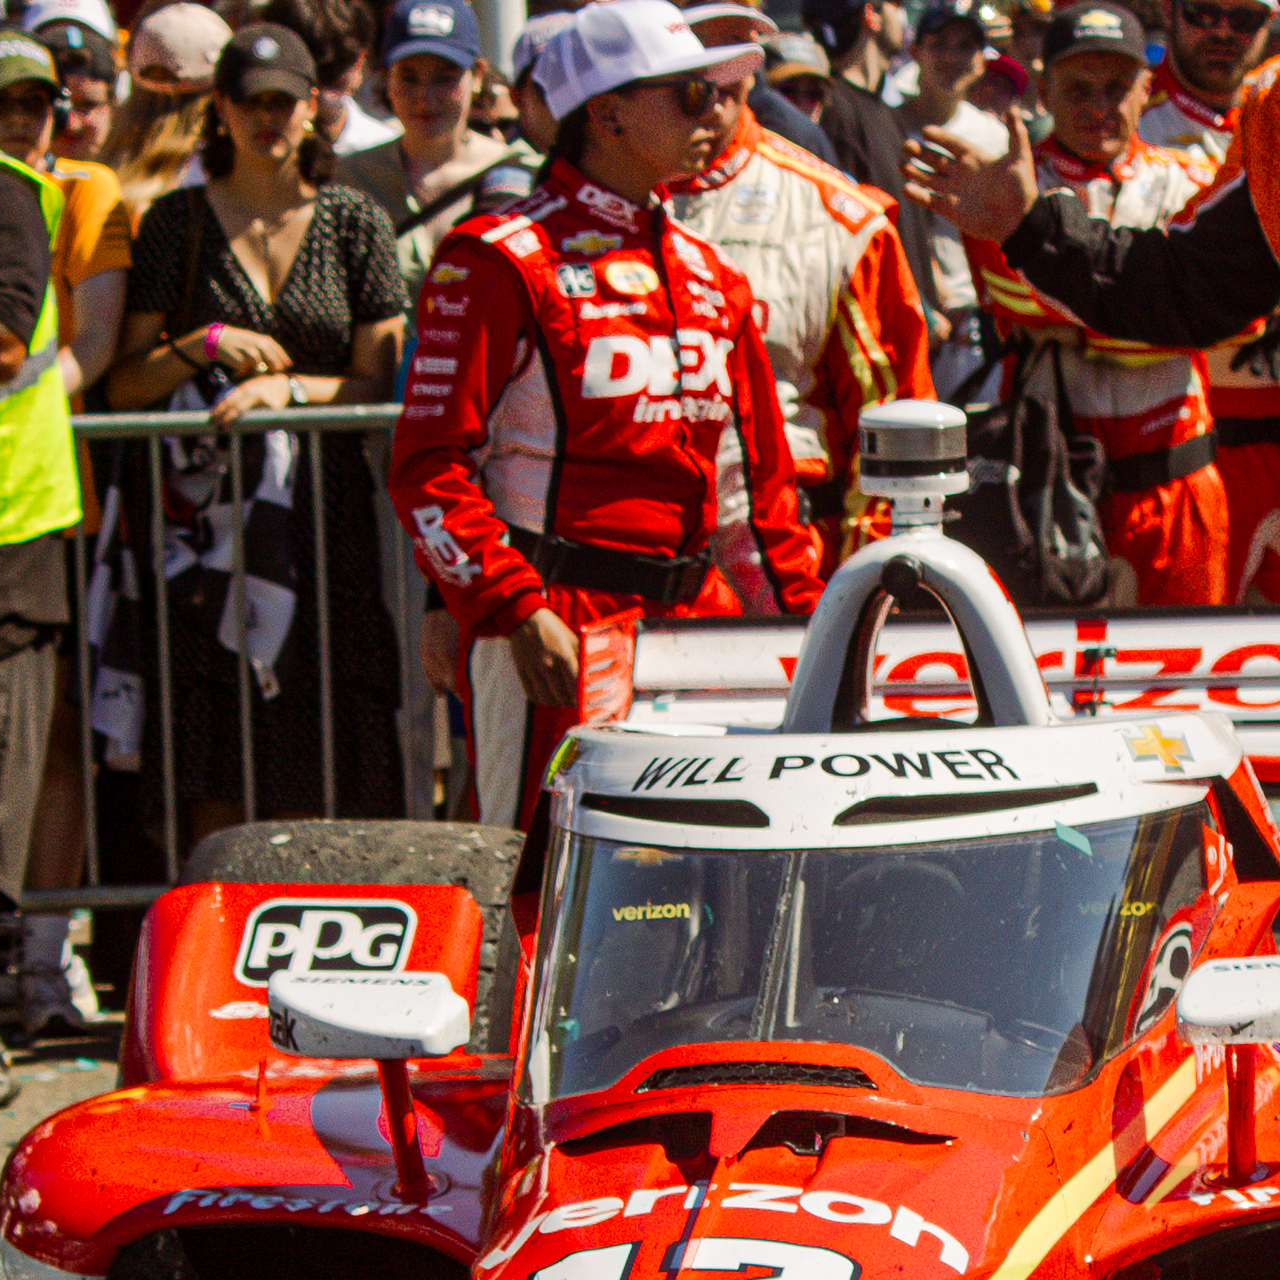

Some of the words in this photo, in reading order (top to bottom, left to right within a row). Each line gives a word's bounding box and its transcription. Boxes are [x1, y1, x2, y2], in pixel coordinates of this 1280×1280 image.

[631, 756, 744, 793] WILL
[768, 748, 1022, 781] POWER
[612, 900, 691, 923] verizon
[248, 910, 405, 972] PPG
[480, 1180, 970, 1276] verizon
